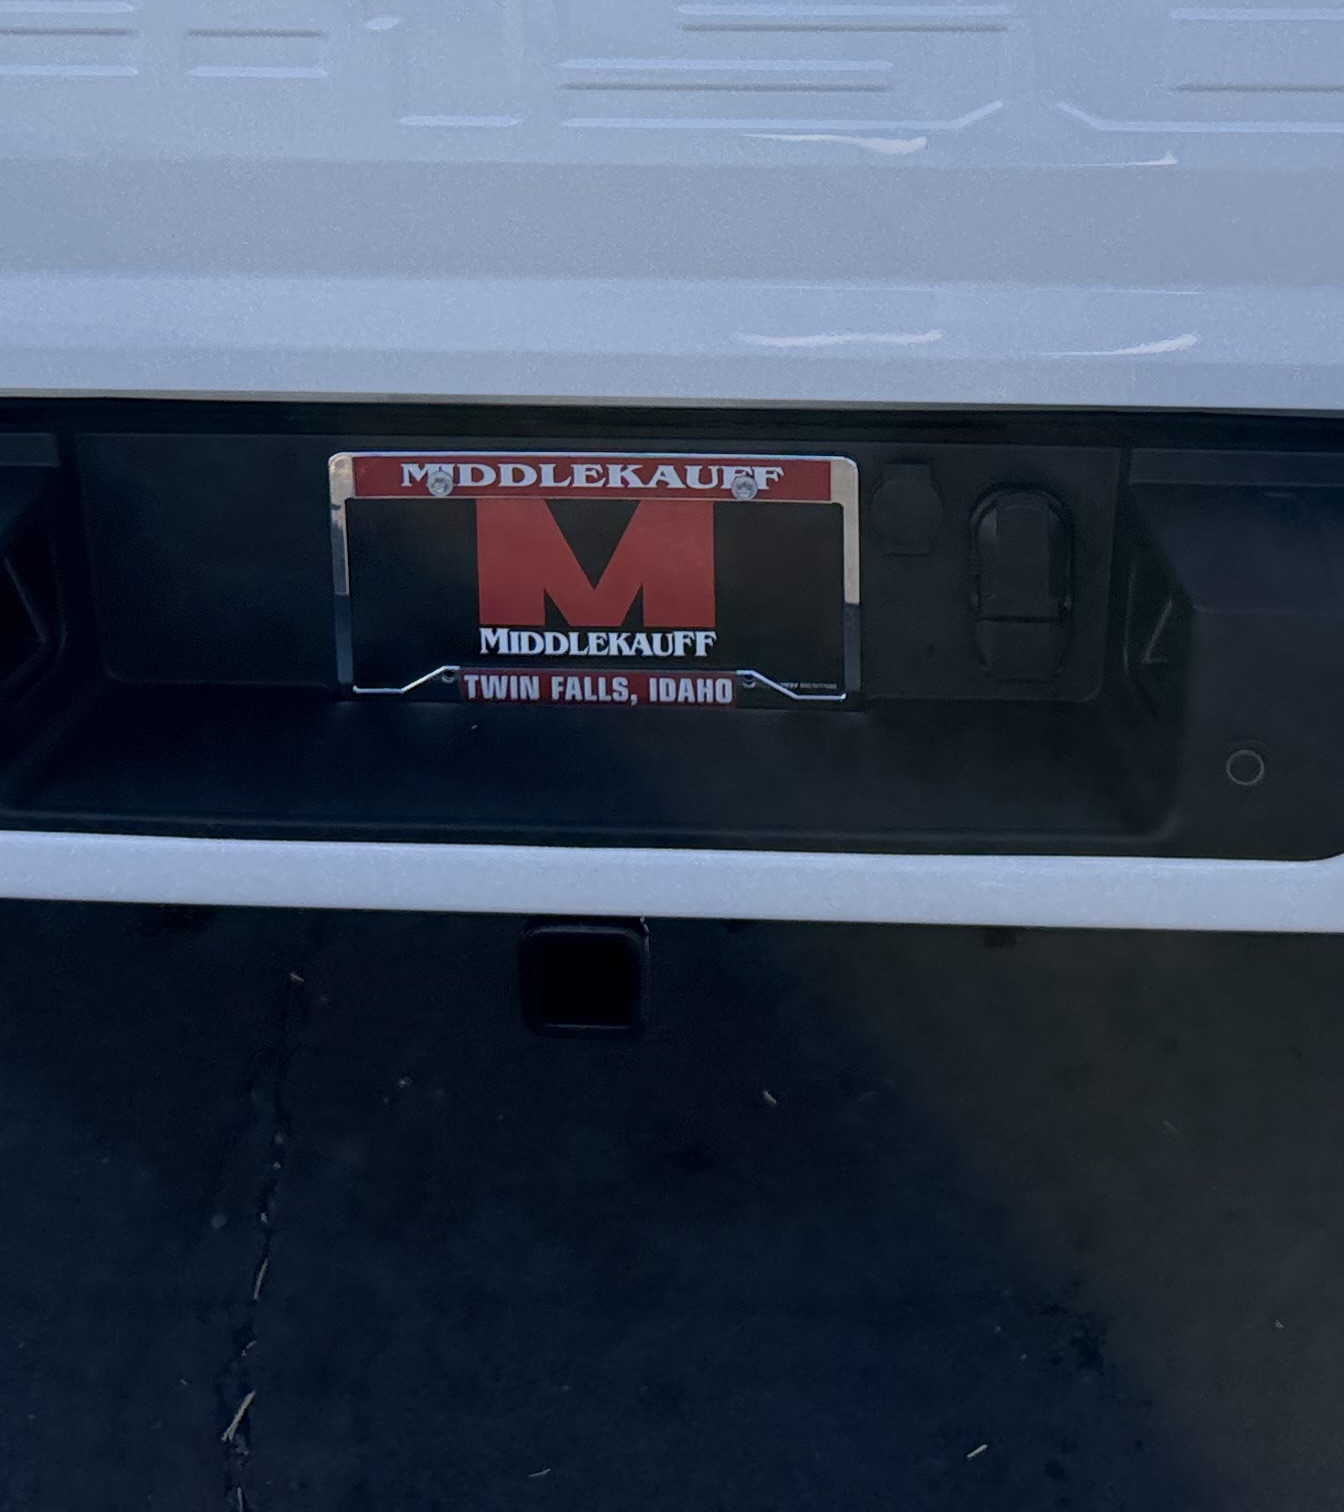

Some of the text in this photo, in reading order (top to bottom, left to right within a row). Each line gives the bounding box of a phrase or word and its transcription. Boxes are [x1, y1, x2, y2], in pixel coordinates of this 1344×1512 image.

[479, 627, 718, 657] MIDDLEKAUFF
[463, 674, 734, 707] TWIN FALLS, IDAHO
